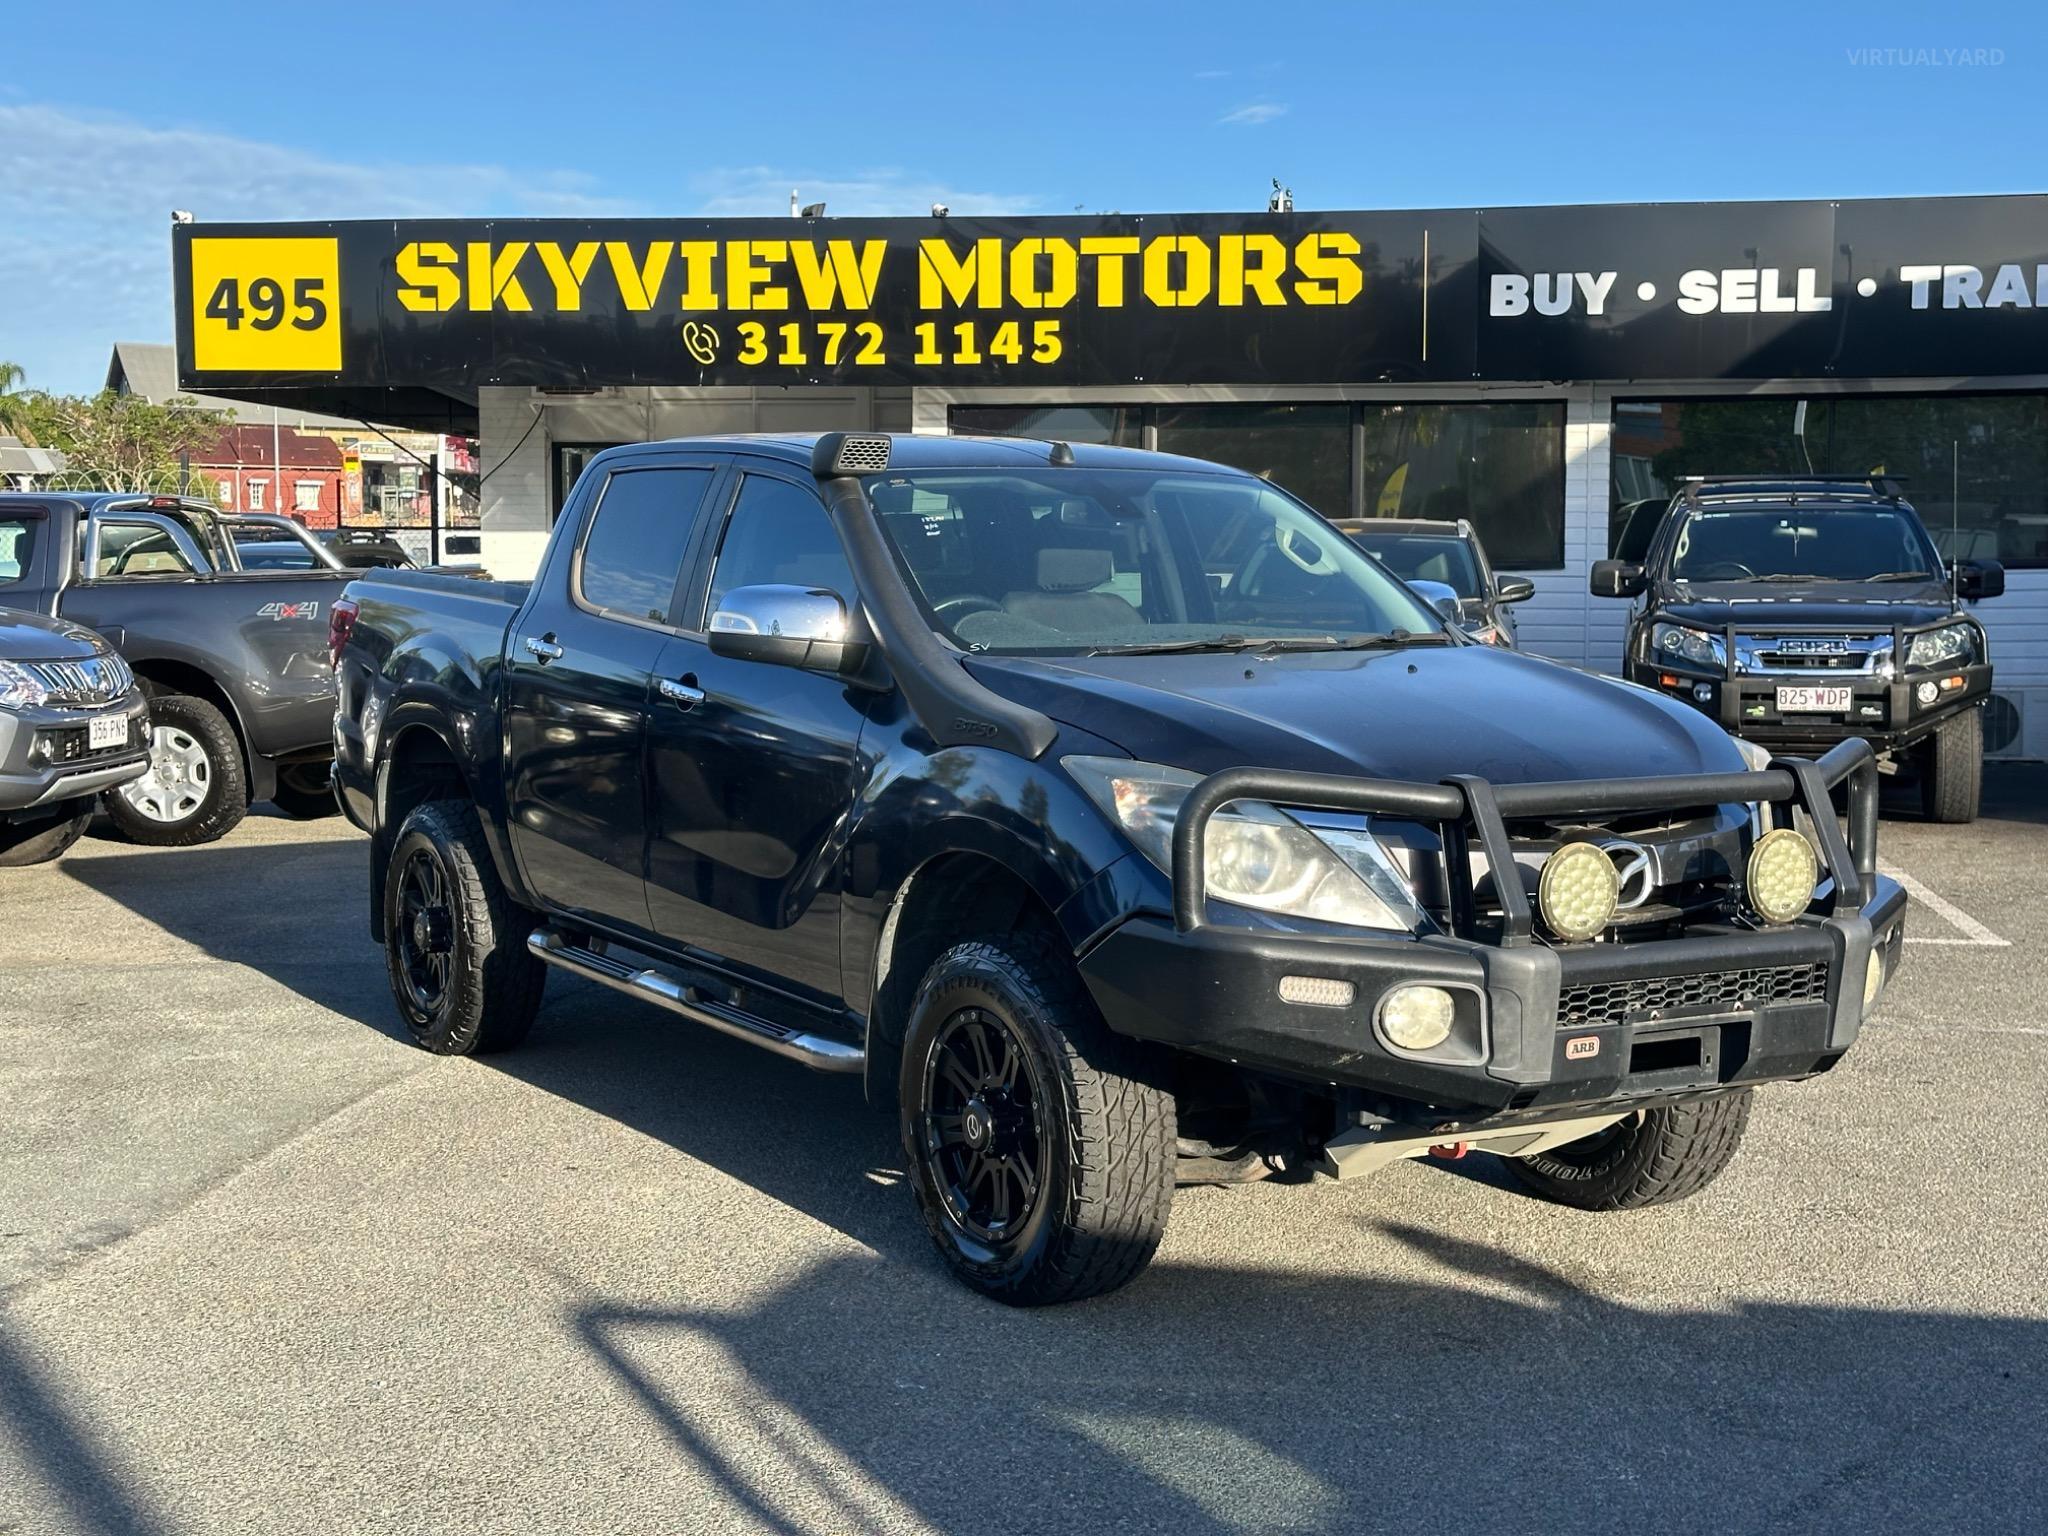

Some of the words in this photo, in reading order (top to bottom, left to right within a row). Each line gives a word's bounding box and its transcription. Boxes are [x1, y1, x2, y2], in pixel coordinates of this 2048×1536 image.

[395, 239, 888, 312] SKYVIEW
[918, 232, 1363, 310] MOTORS
[1489, 271, 1618, 317] BUY
[1676, 267, 1833, 315] SELL
[205, 277, 327, 332] 495
[737, 321, 886, 366] 3172
[914, 319, 1062, 365] 1145
[1780, 640, 1846, 653] ISUZU
[1571, 1041, 1595, 1055] ARB
